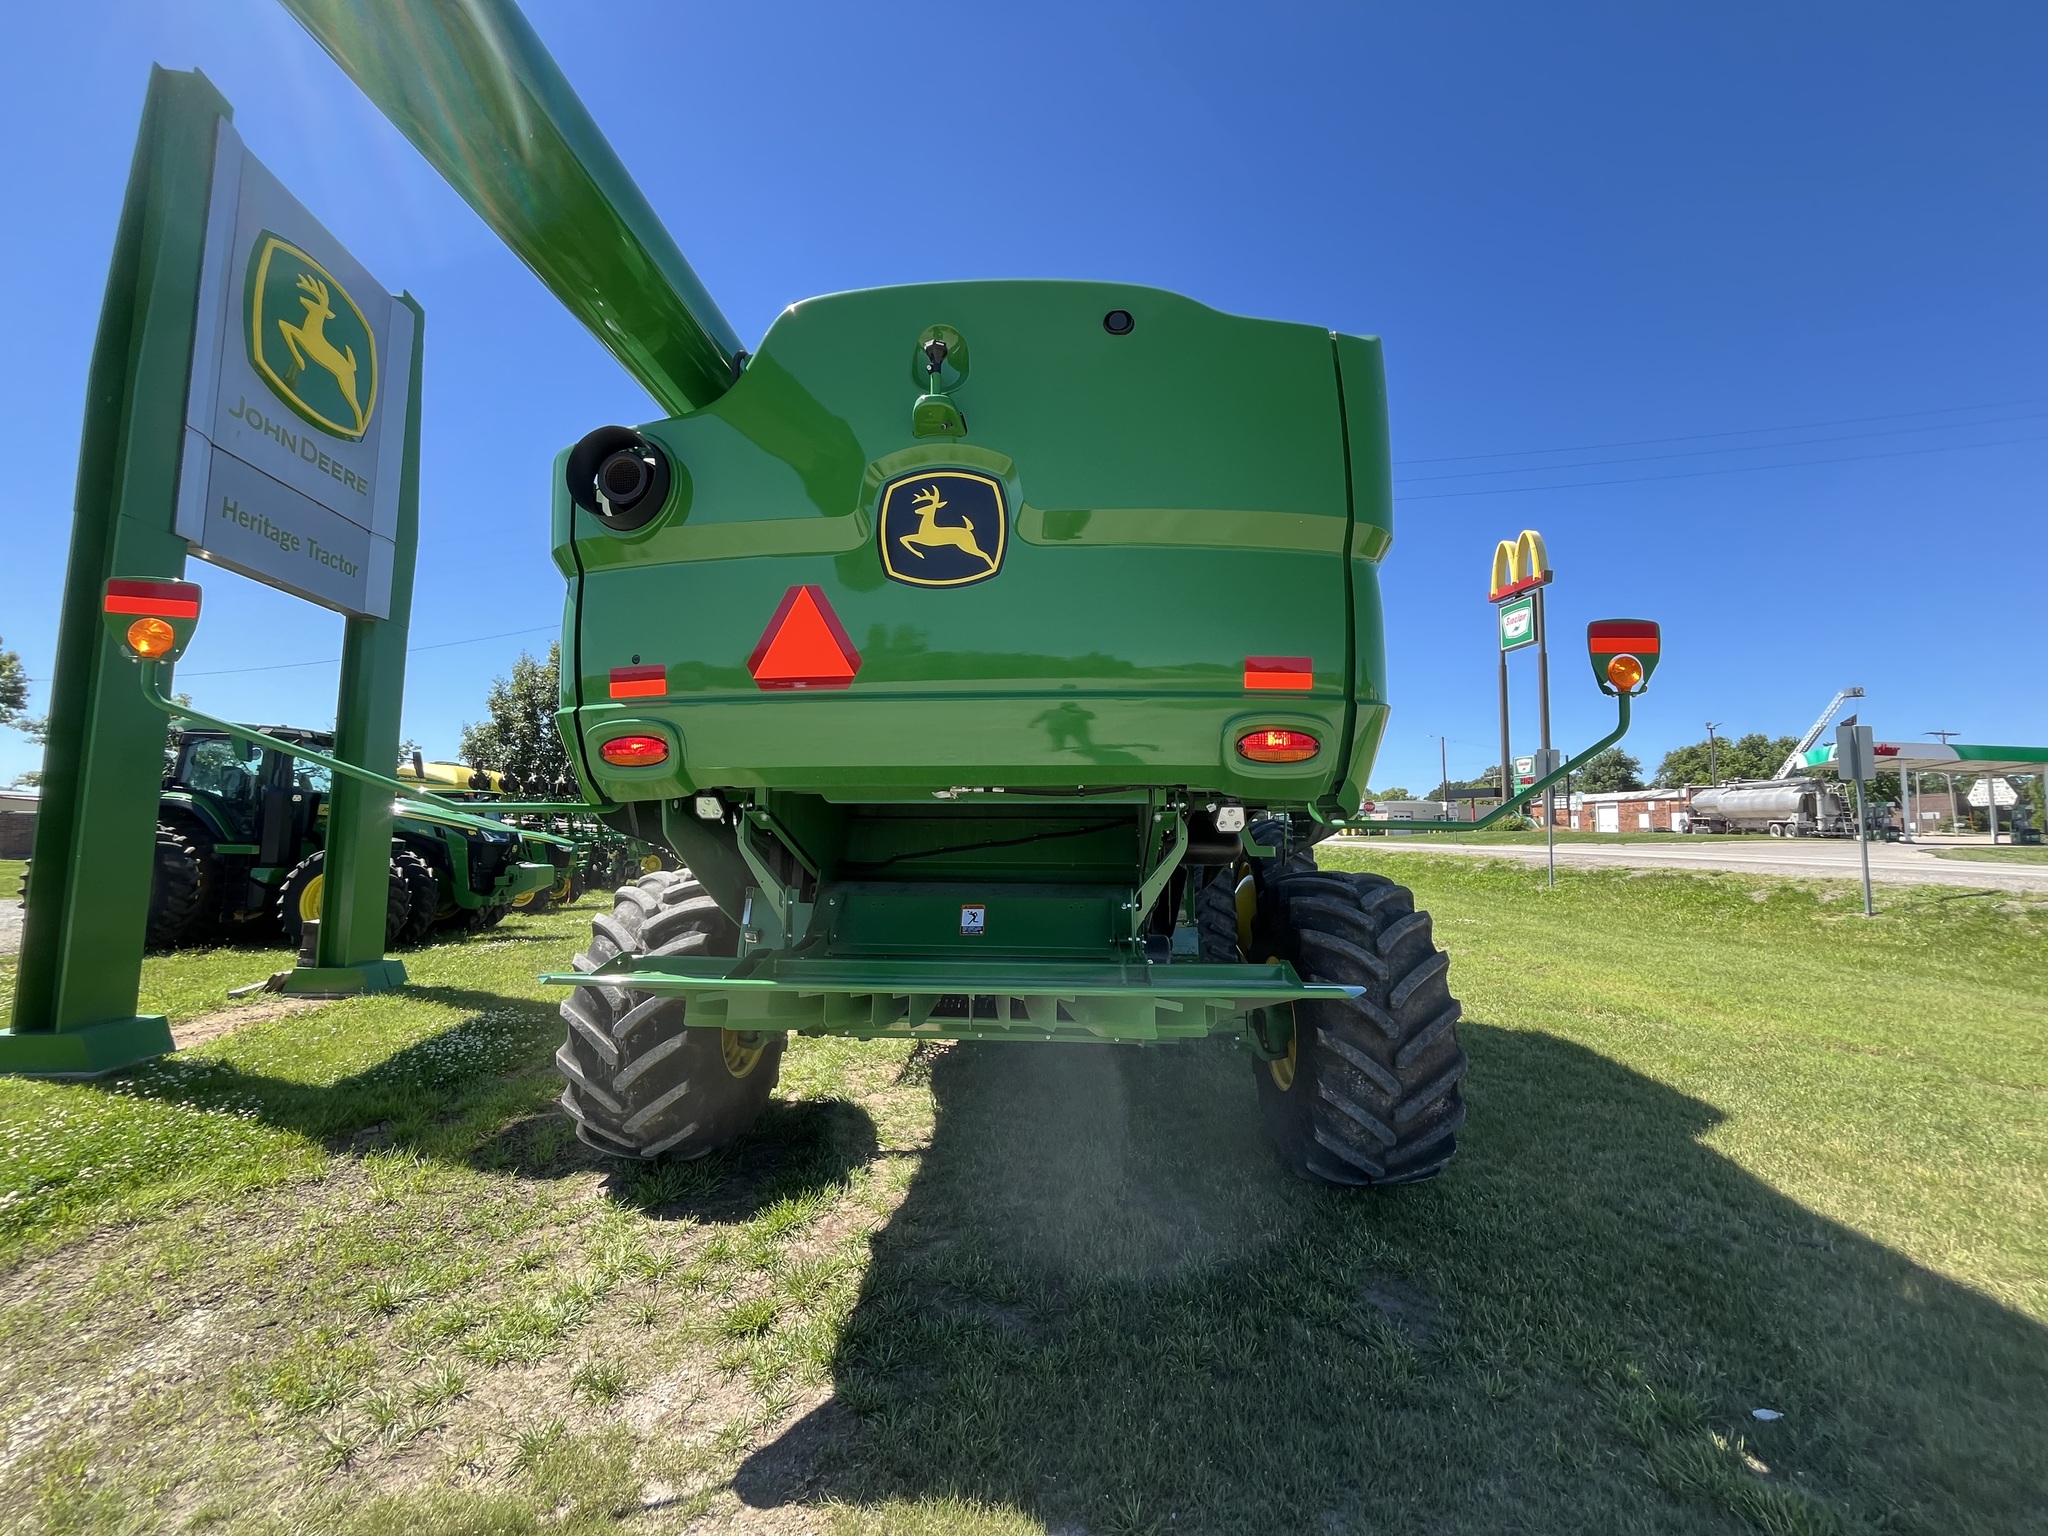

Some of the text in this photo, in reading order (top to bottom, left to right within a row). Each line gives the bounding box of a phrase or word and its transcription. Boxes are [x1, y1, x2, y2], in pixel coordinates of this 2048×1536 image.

[228, 395, 369, 497] JOHN DEERE
[222, 495, 359, 579] Heritage Tractor
